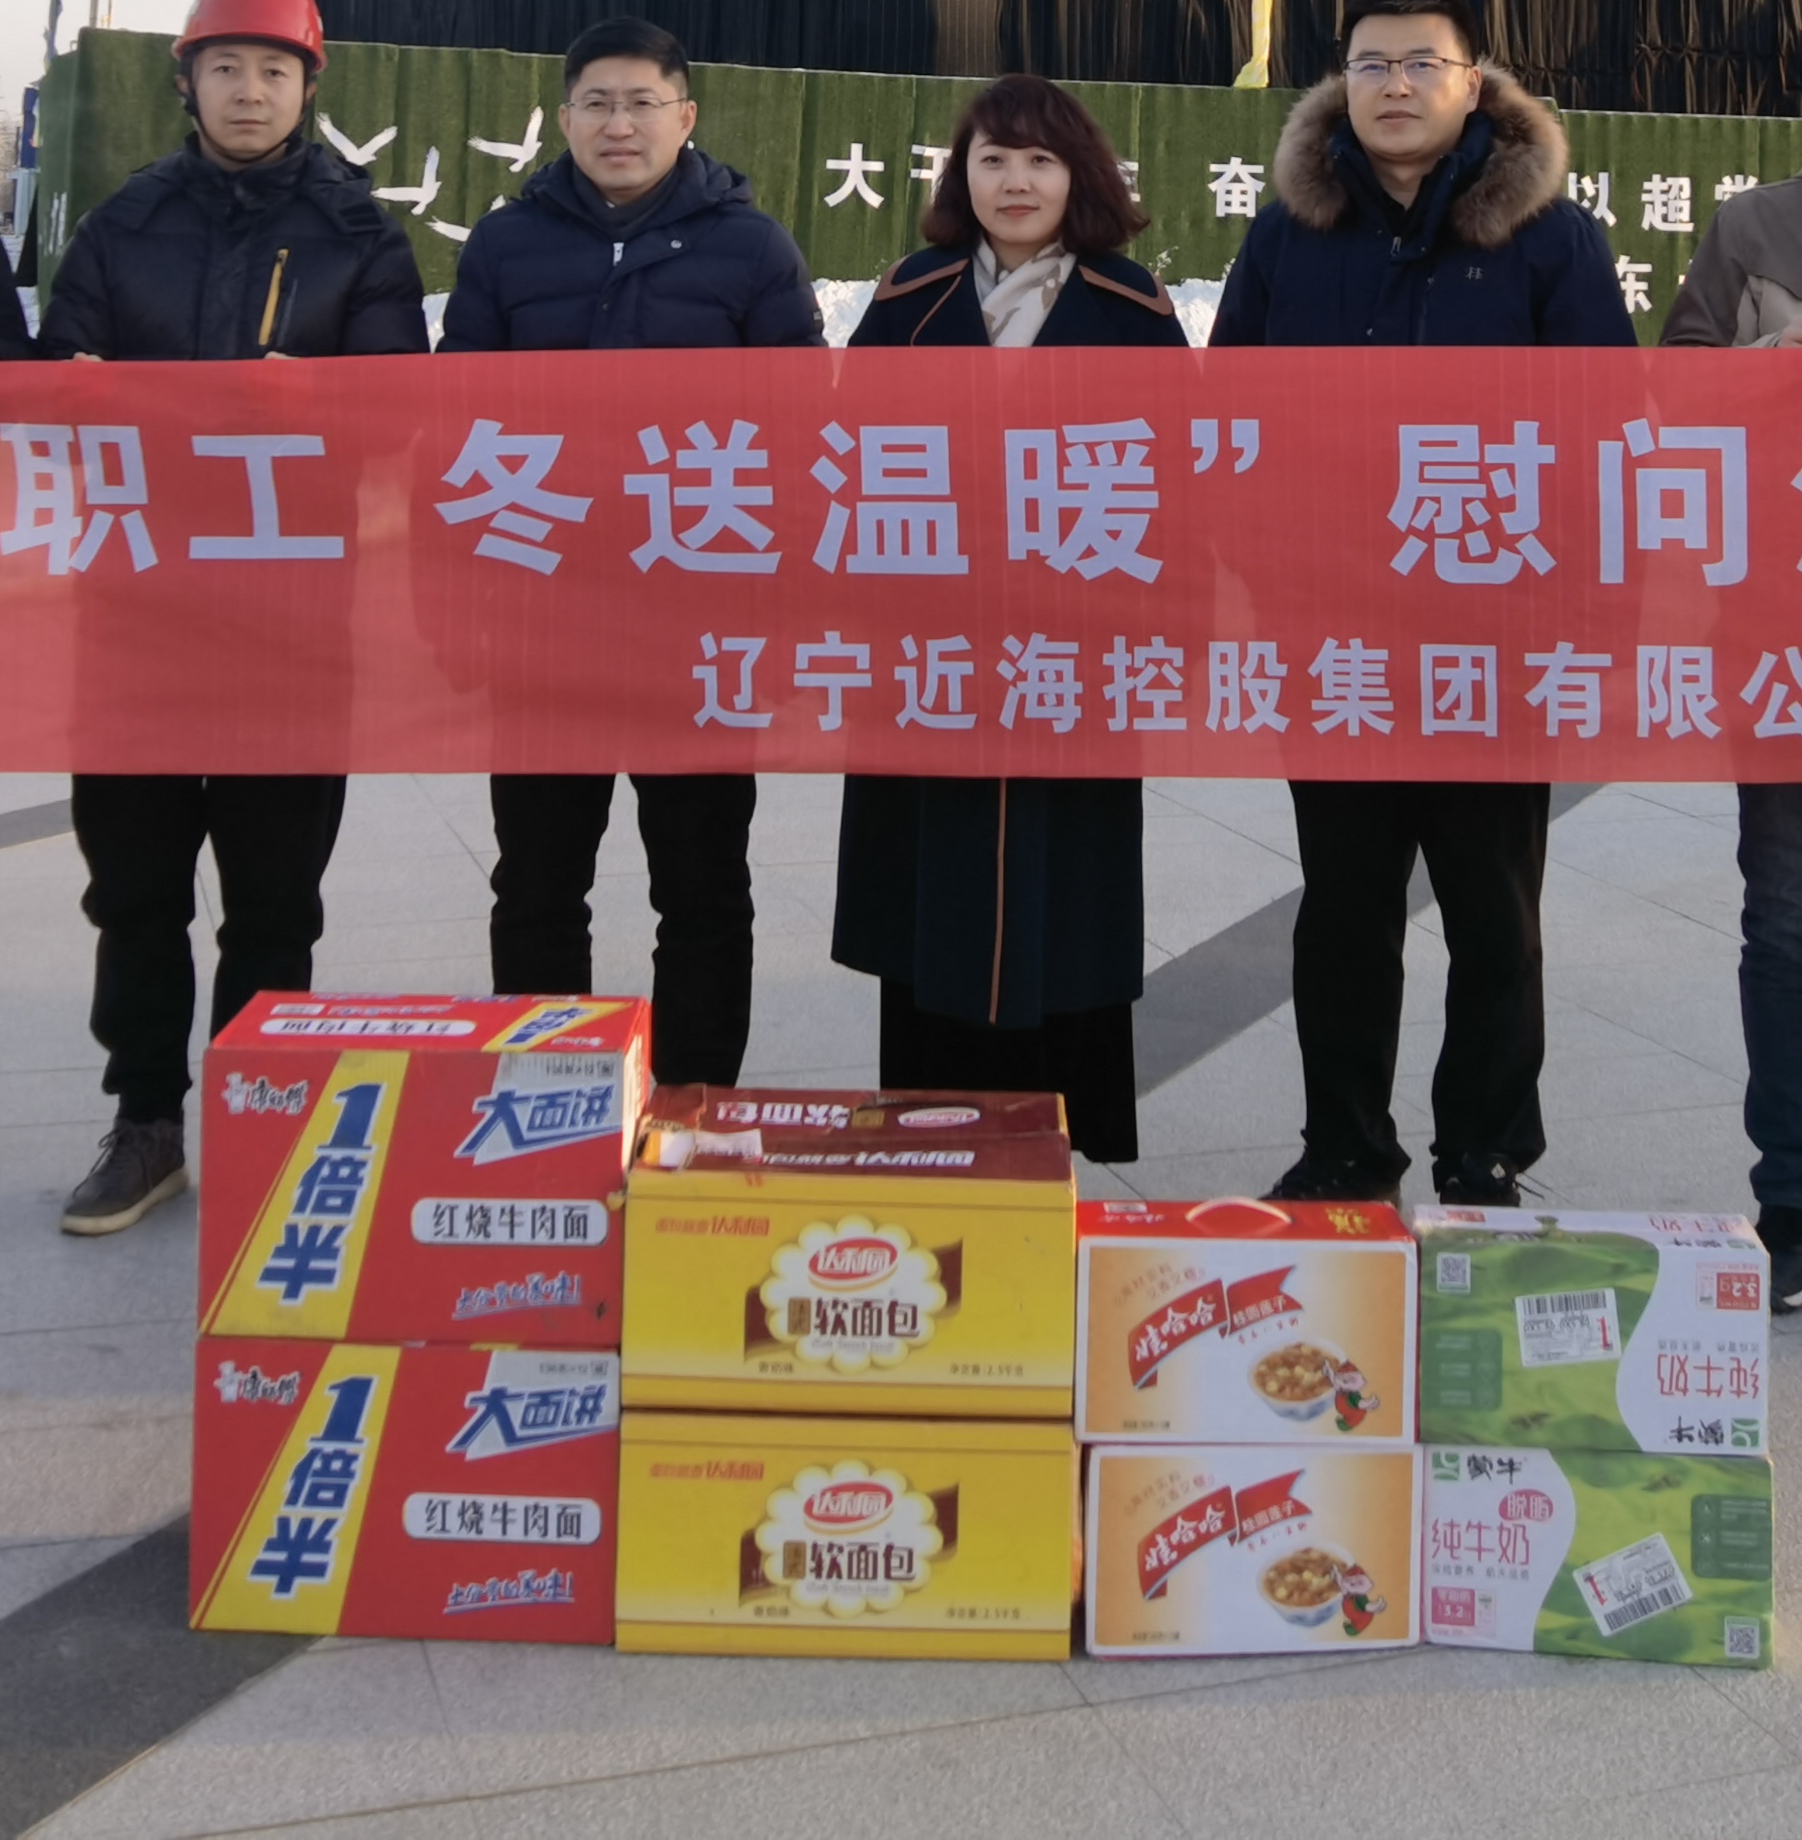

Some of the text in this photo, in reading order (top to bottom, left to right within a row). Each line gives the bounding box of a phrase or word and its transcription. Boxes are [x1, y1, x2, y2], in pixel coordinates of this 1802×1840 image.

[459, 1084, 615, 1156] 大面饼
[431, 1202, 590, 1242] 红烧牛肉面
[816, 1240, 892, 1275] 达利园
[1134, 1296, 1217, 1362] 娃哈哈
[1657, 1353, 1760, 1399] 纯牛奶
[451, 1384, 608, 1451] 大面饼
[1669, 1415, 1725, 1447] 蒙牛
[1466, 1453, 1522, 1485] 蒙牛
[424, 1498, 583, 1538] 红烧牛肉面
[812, 1484, 887, 1518] 达利园
[1506, 1492, 1551, 1521] 脱脂
[1145, 1503, 1226, 1572] 娃哈哈
[1430, 1518, 1531, 1566] 纯牛奶
